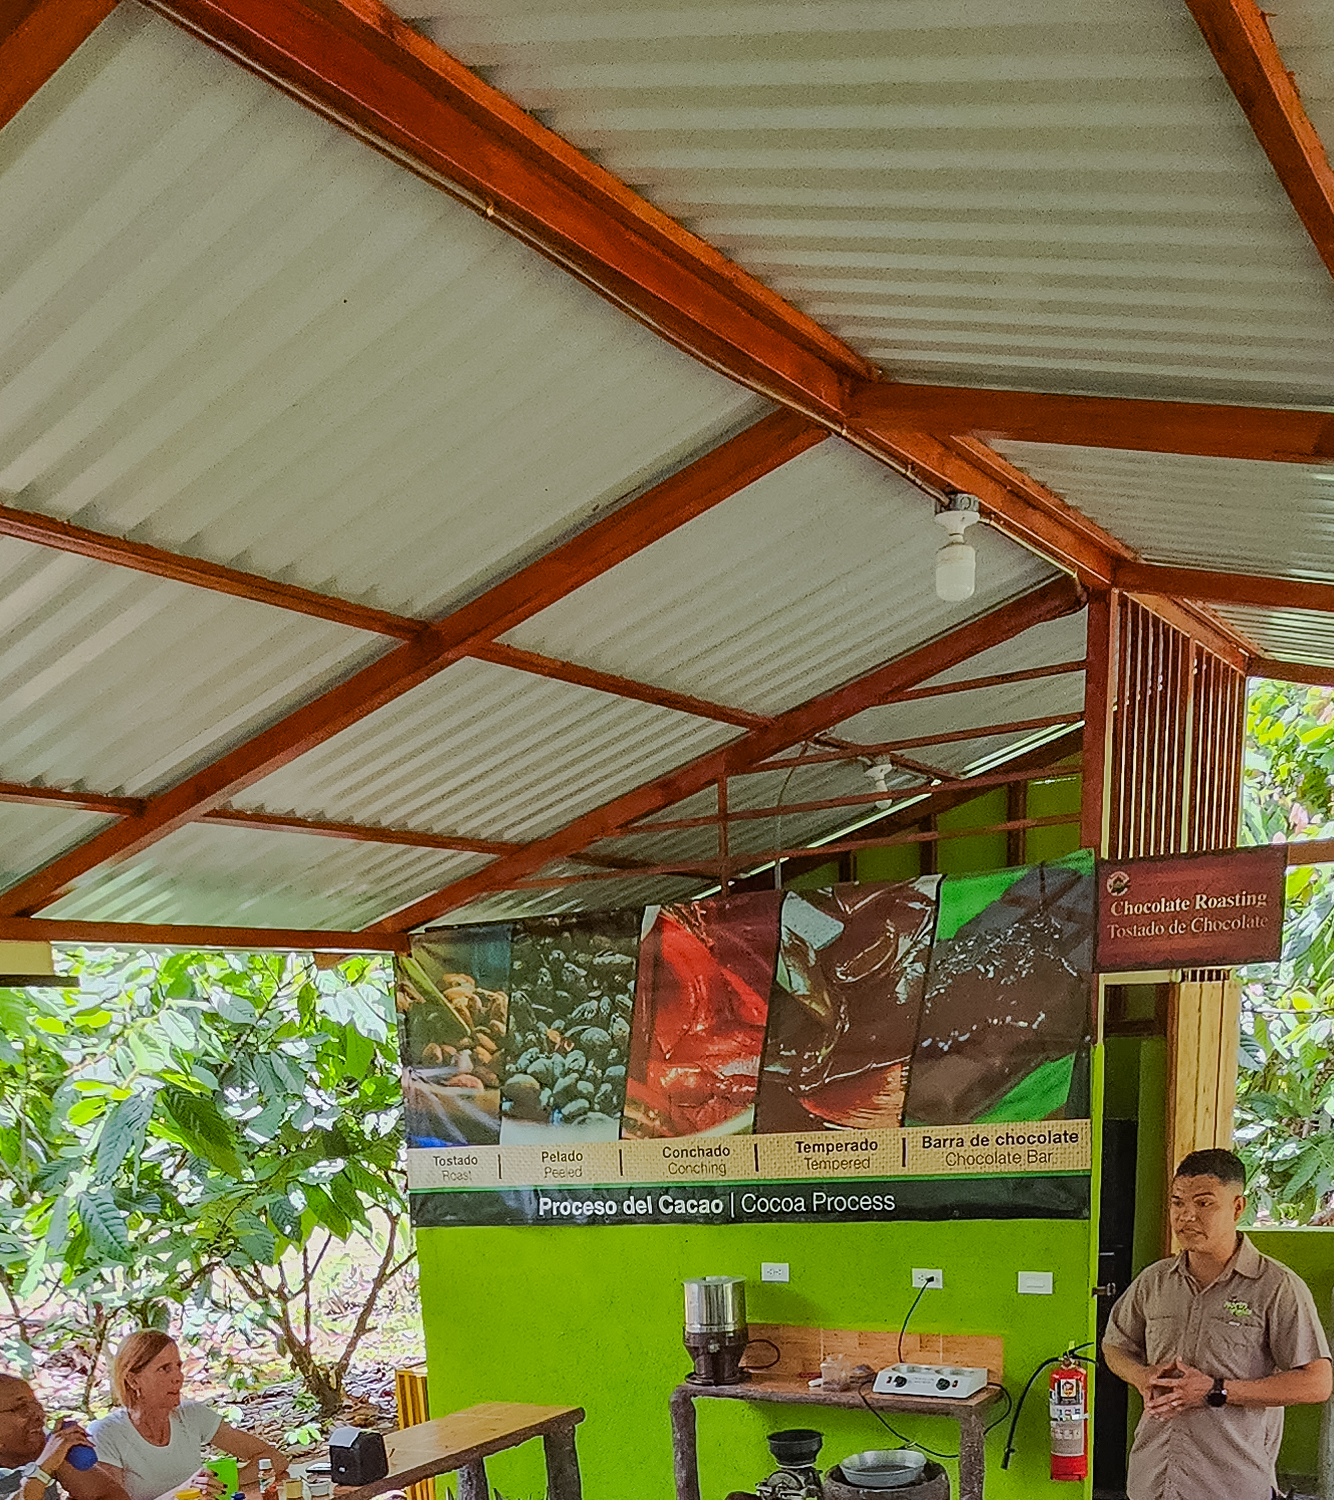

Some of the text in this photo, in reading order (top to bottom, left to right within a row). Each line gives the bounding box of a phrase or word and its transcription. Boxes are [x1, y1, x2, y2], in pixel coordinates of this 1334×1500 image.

[1110, 890, 1267, 917] Chocolate Roasting
[1107, 913, 1269, 939] Tostado de Chocolate
[795, 1139, 879, 1156] Temperado
[921, 1129, 1079, 1149] Barra de chocolate
[541, 1150, 584, 1163] Pelado
[662, 1144, 731, 1159] Conchado
[945, 1149, 1053, 1167] Chocolate Bar
[433, 1154, 478, 1167] Tostado
[667, 1161, 727, 1177] Conching
[804, 1156, 871, 1173] Tempered
[544, 1165, 583, 1179] Peeed
[538, 1191, 896, 1216] Proceso del Cacao Cocoa Process
